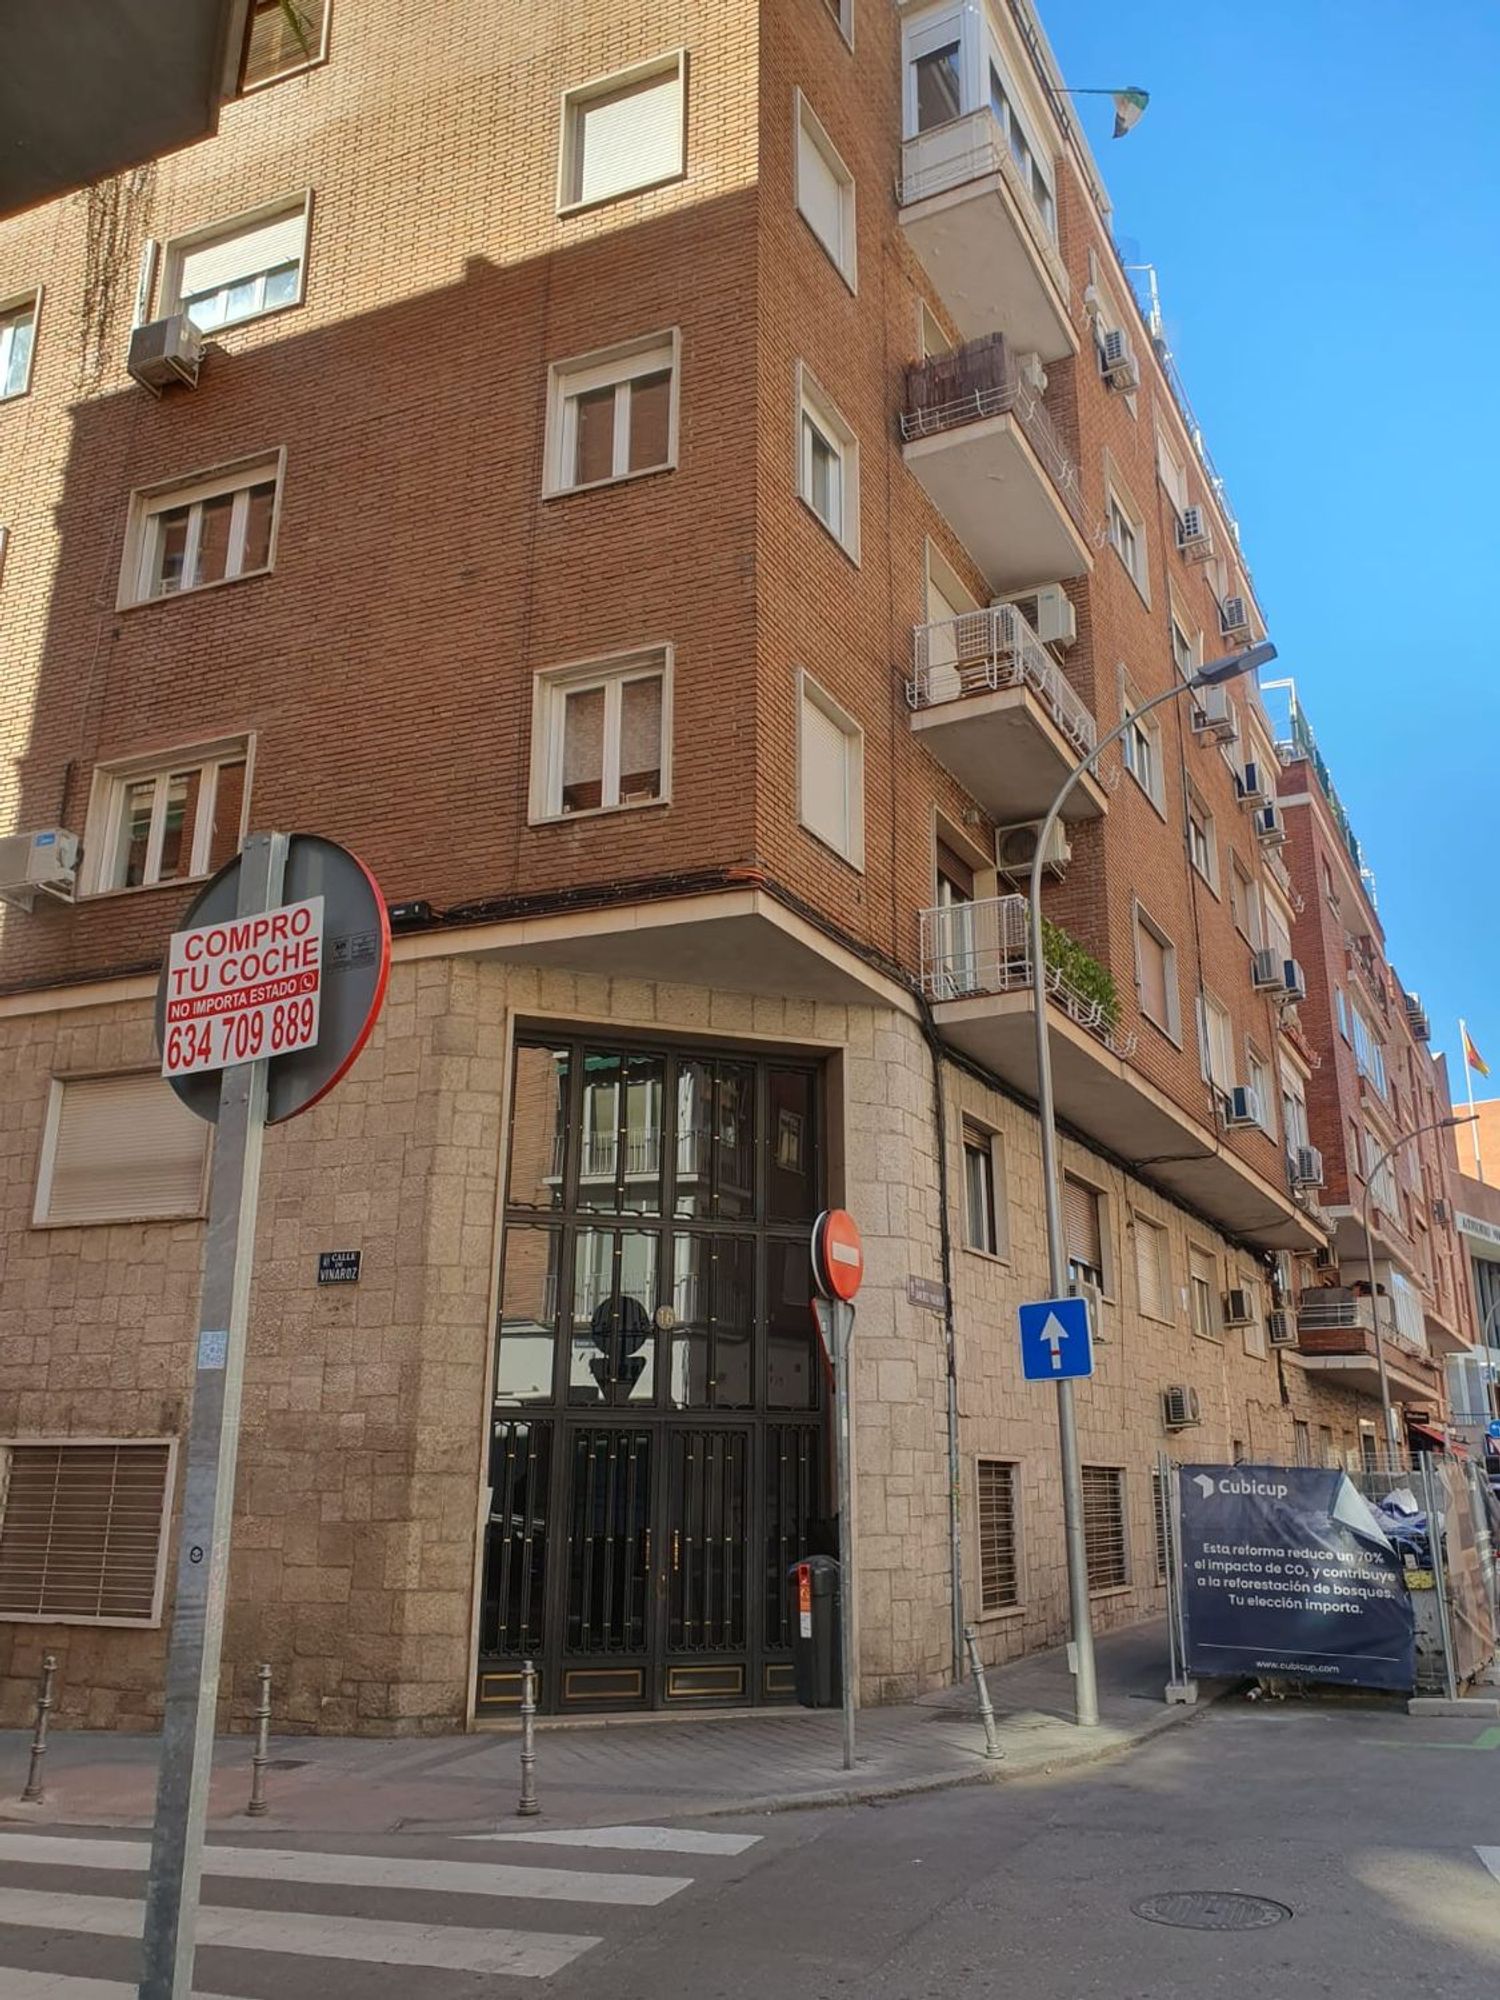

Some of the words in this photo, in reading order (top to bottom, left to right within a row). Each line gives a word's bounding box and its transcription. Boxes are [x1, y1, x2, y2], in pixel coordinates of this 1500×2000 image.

[185, 908, 311, 962] COMPRO
[172, 964, 208, 995] TU
[219, 937, 319, 987] COCHE
[171, 1003, 190, 1019] NO
[193, 993, 248, 1015] IMPORTA
[250, 981, 297, 1003] ESTADO
[167, 1021, 212, 1070] 634
[222, 1010, 264, 1061] 709
[271, 997, 314, 1051] 889
[320, 1267, 357, 1280] VINAROZ
[1218, 1479, 1288, 1500] Cubicup
[1203, 1543, 1230, 1555] Esta
[1233, 1544, 1285, 1557] reforma
[1287, 1548, 1334, 1560] reduce
[1336, 1551, 1354, 1561] un
[1357, 1551, 1385, 1564] 70%
[1194, 1559, 1206, 1570] el
[1208, 1559, 1262, 1574] impacto
[1265, 1562, 1282, 1574] de
[1311, 1567, 1320, 1580] y
[1322, 1568, 1396, 1584] contribuye
[1197, 1577, 1206, 1587] a
[1208, 1576, 1221, 1587] la
[1224, 1577, 1310, 1593] reforestación
[1313, 1583, 1330, 1595] de
[1333, 1584, 1396, 1600] bosques.
[1228, 1594, 1244, 1606] Tu
[1247, 1595, 1303, 1609] elección
[1305, 1598, 1363, 1615] importa.
[1256, 1661, 1339, 1674] www.cubicup.com
